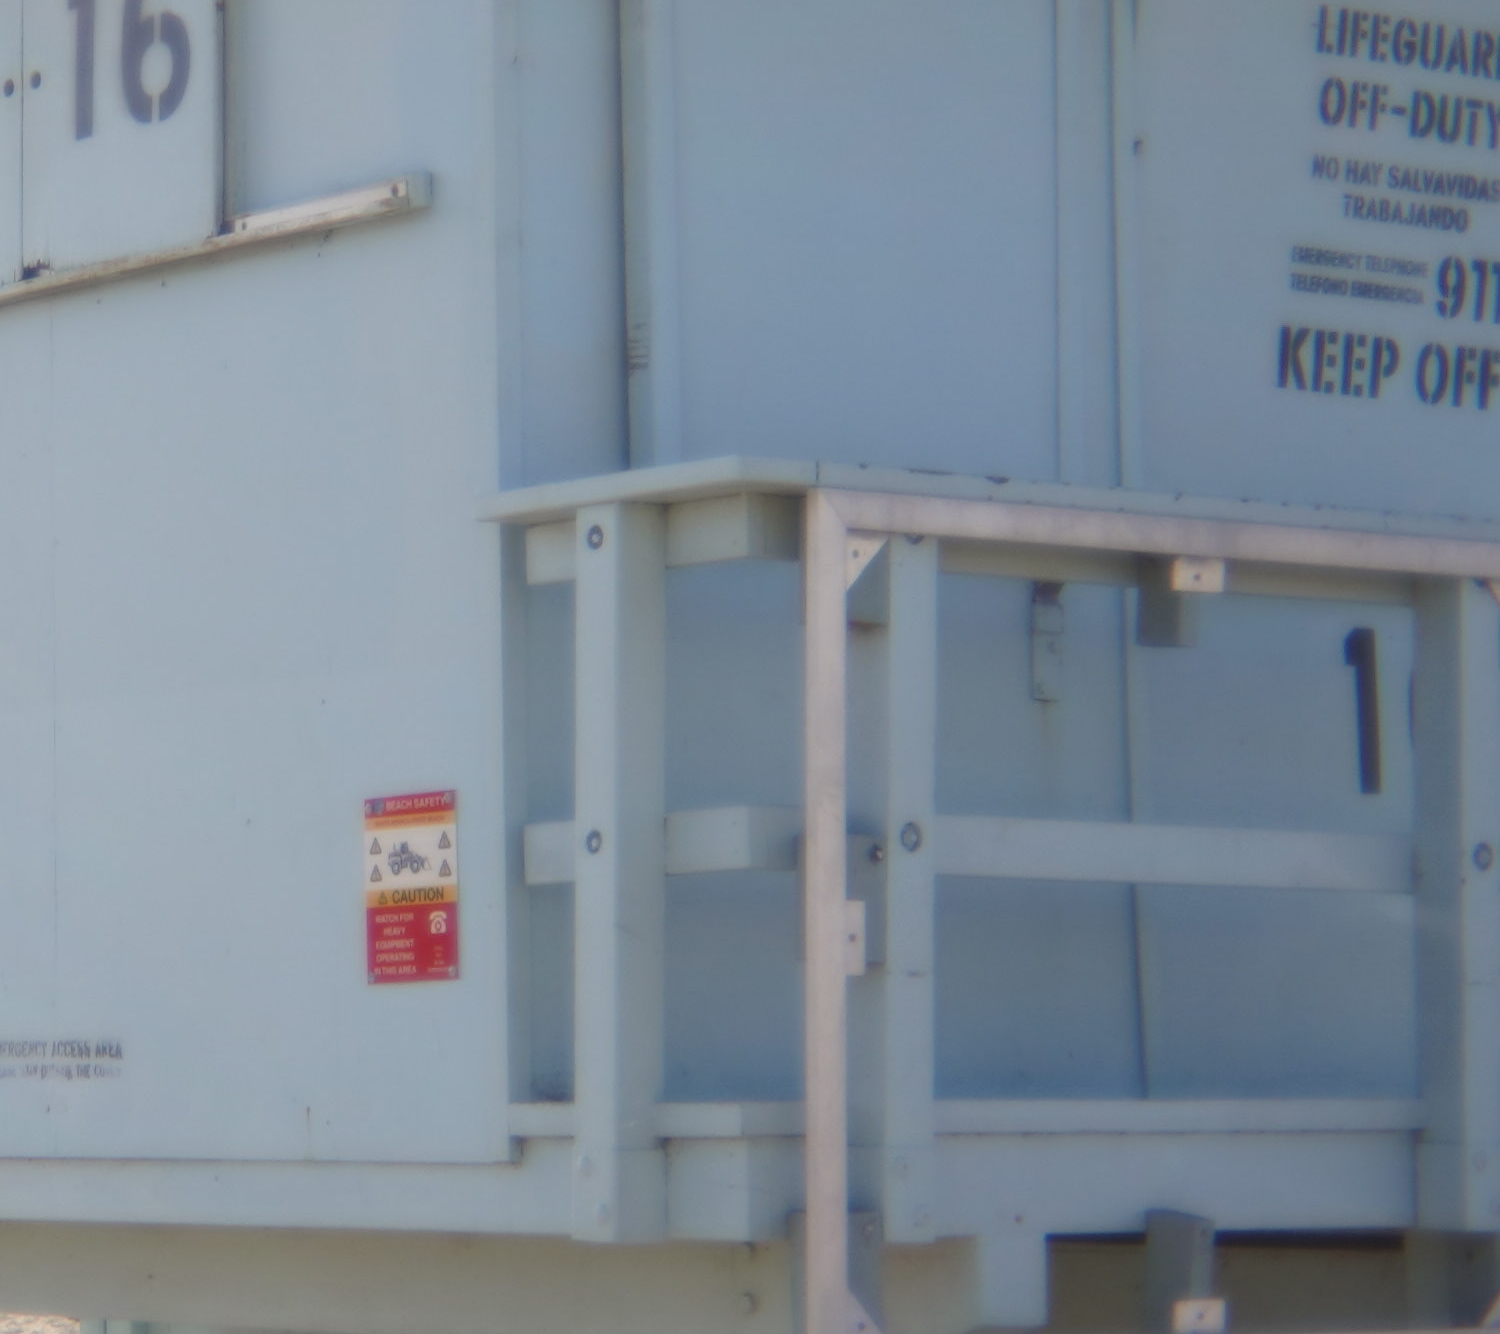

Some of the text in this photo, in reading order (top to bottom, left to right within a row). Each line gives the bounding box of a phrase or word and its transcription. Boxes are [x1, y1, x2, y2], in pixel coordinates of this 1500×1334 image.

[1312, 155, 1340, 182] NO
[1345, 159, 1383, 188] HAY
[1342, 194, 1471, 234] TRABAJANDO
[1276, 324, 1399, 399] KEEP
[385, 796, 445, 812] BEACH SAFETY
[392, 887, 444, 904] CAUTION
[400, 913, 414, 922] FOR
[51, 1041, 91, 1059] ACCESS
